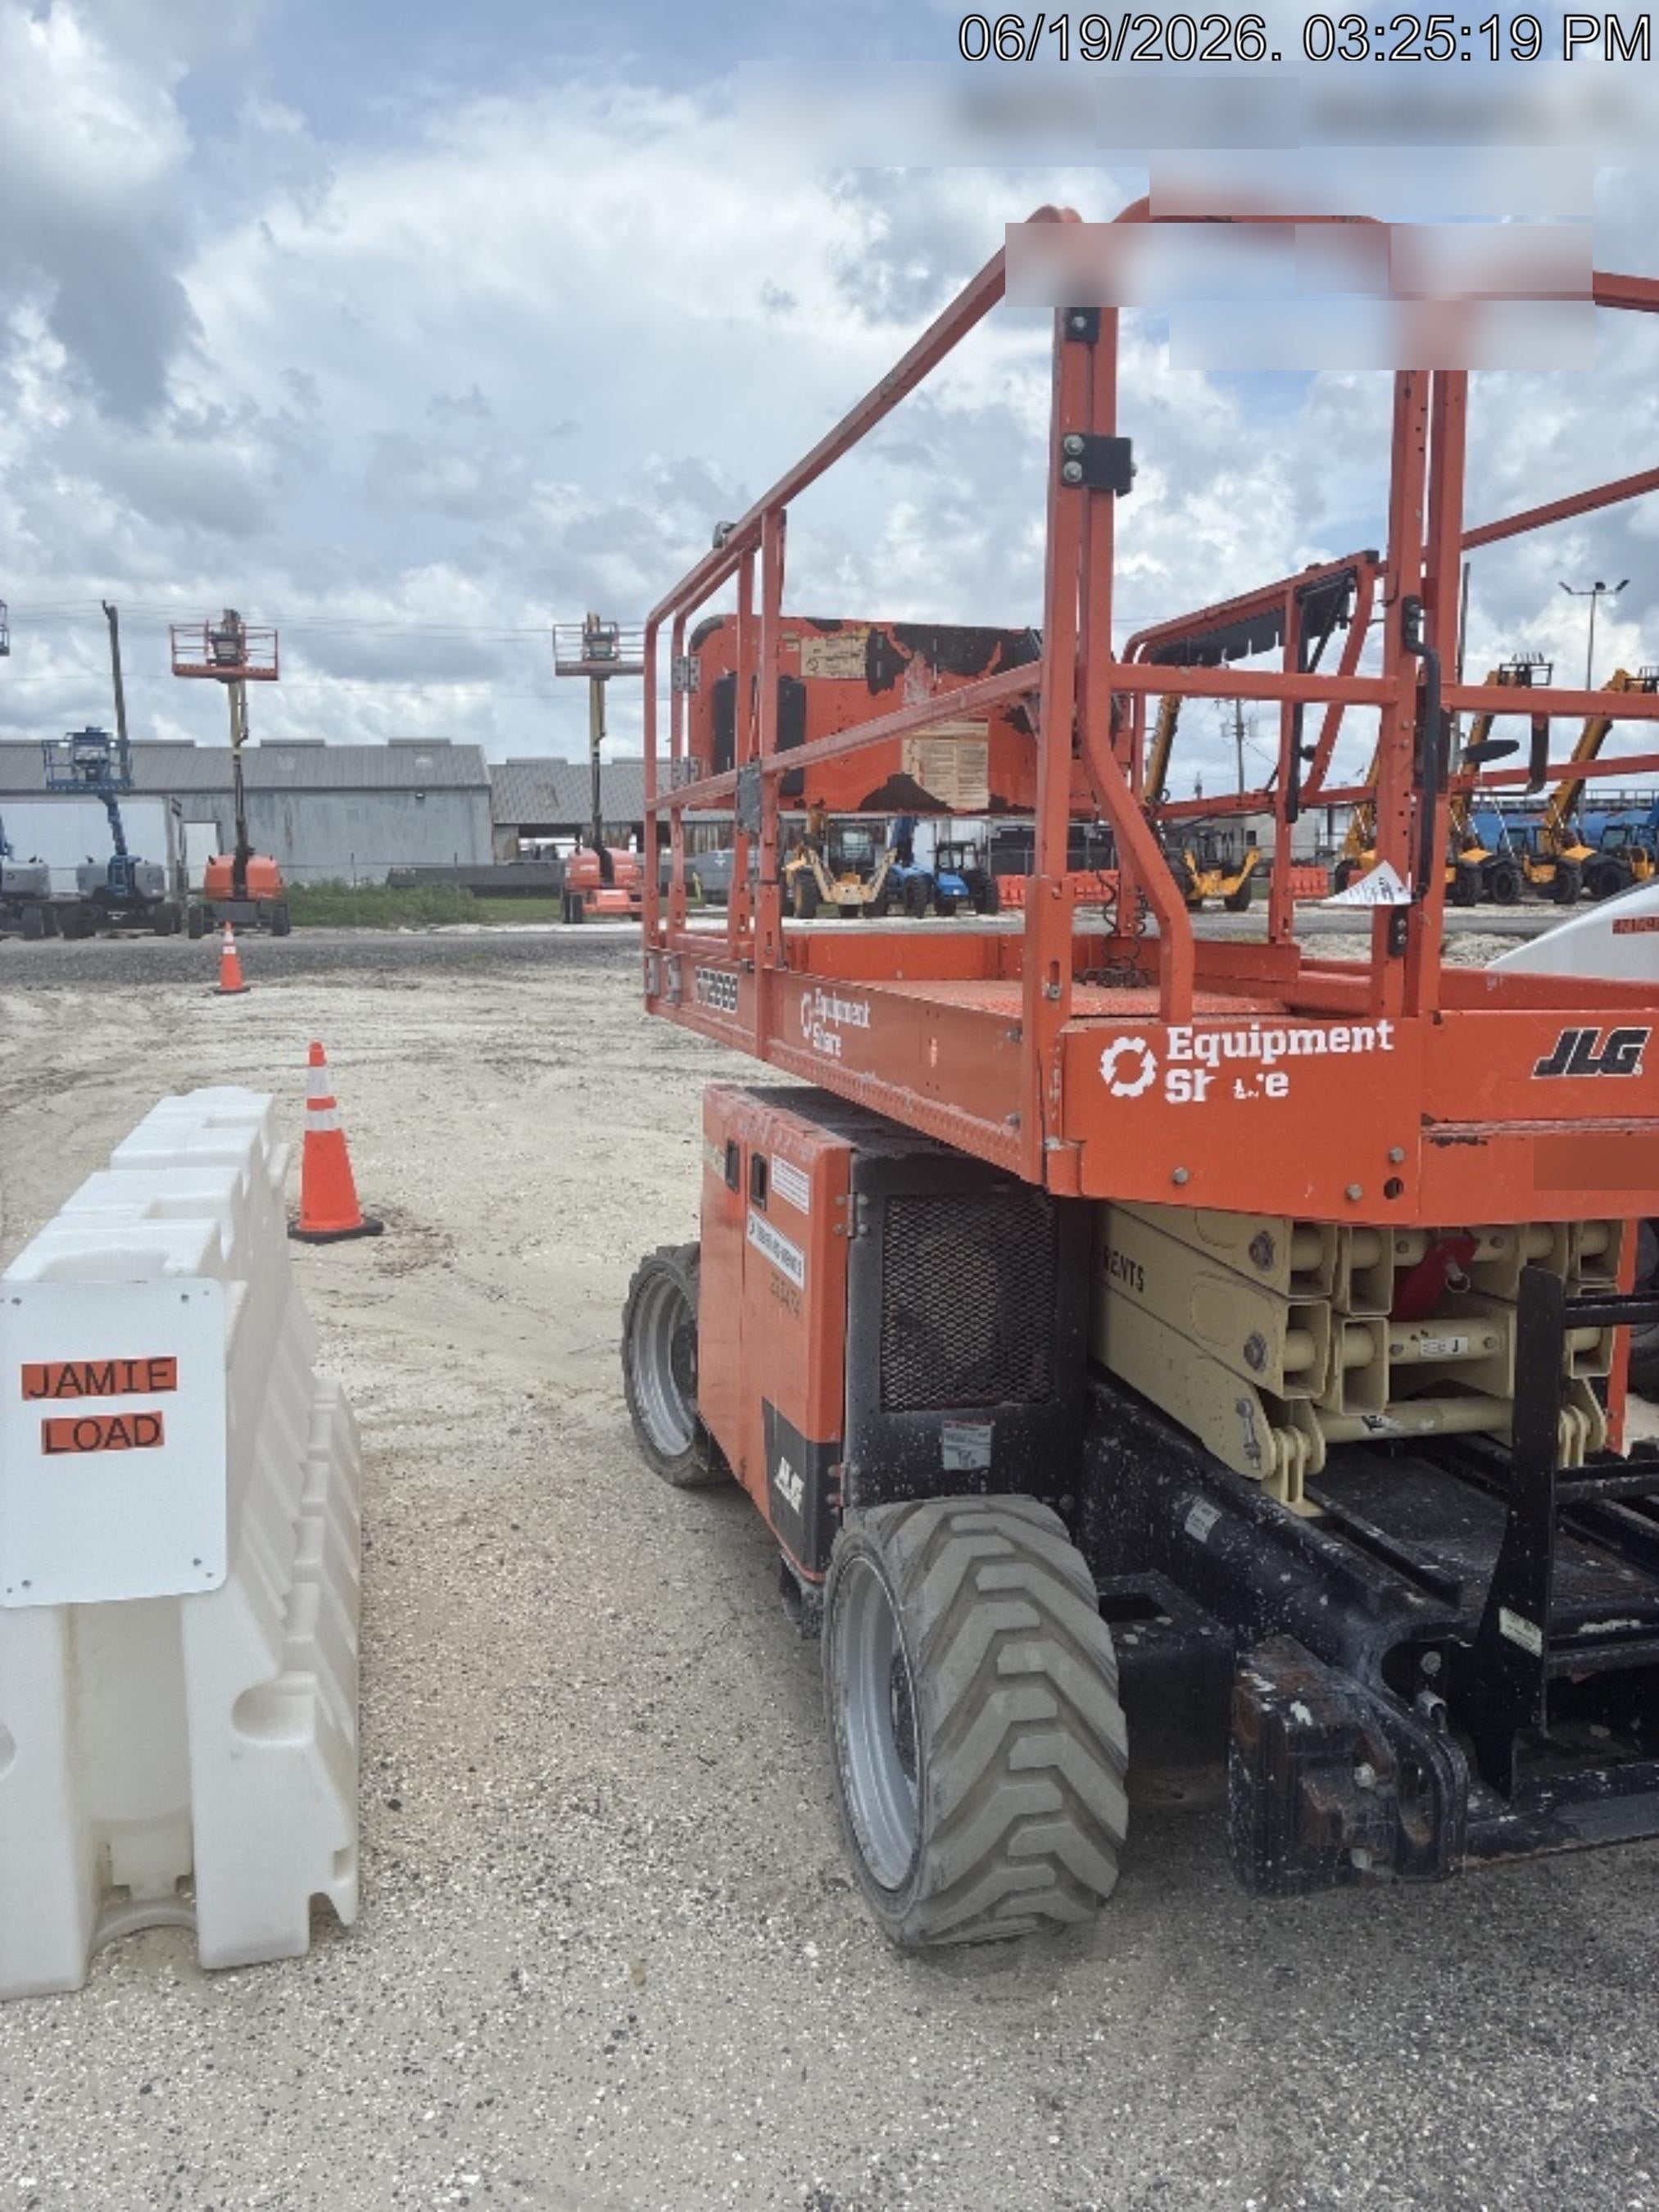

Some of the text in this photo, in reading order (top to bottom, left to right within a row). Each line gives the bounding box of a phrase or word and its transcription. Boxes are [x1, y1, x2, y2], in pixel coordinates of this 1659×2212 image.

[815, 988, 870, 1028] Equipment
[813, 1023, 841, 1057] Share
[1167, 1019, 1394, 1067] Equipment
[1530, 1027, 1652, 1079] JLG
[29, 1358, 173, 1398] JAMIE
[45, 1415, 160, 1453] LOAD
[773, 1457, 804, 1514] JLG
